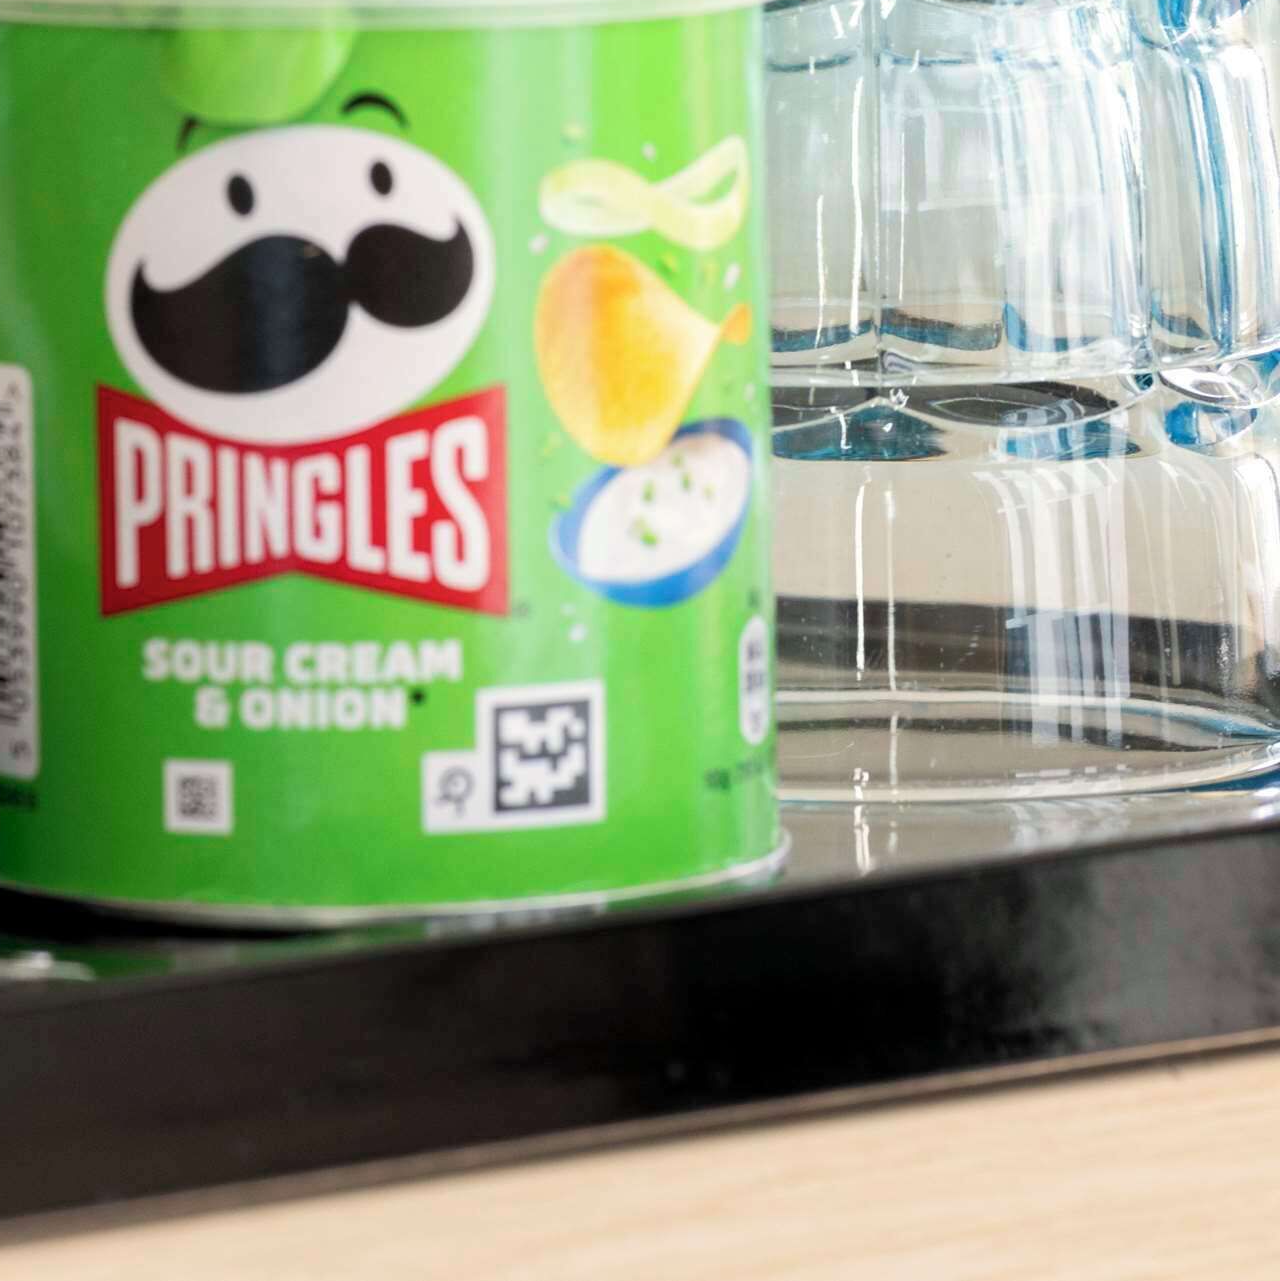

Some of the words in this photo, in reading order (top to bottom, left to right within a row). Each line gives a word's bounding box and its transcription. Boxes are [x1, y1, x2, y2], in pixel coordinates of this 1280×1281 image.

[113, 415, 491, 593] PRINGLES
[142, 636, 274, 684] SOUR
[283, 638, 463, 684] CREAM
[193, 687, 230, 730] &
[240, 686, 408, 732] ONION
